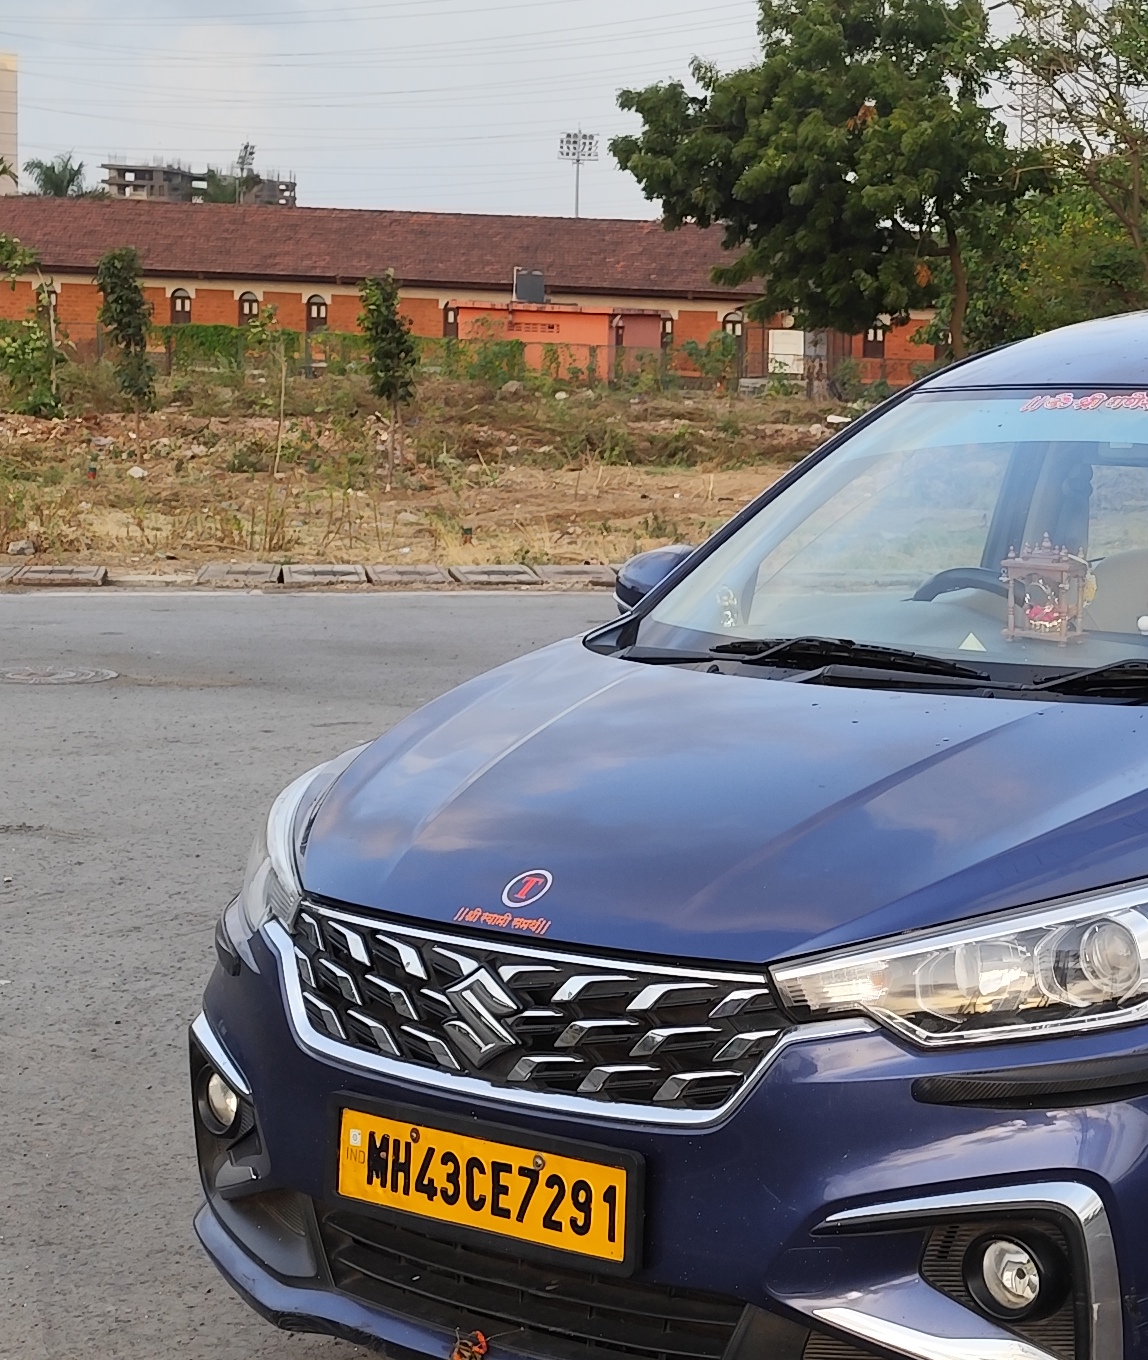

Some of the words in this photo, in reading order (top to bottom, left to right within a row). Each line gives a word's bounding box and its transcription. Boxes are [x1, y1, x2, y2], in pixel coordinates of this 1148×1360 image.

[514, 876, 544, 899] T
[481, 911, 512, 928] स्वामी
[346, 1146, 366, 1164] IND
[367, 1130, 617, 1243] MH43CE7291
